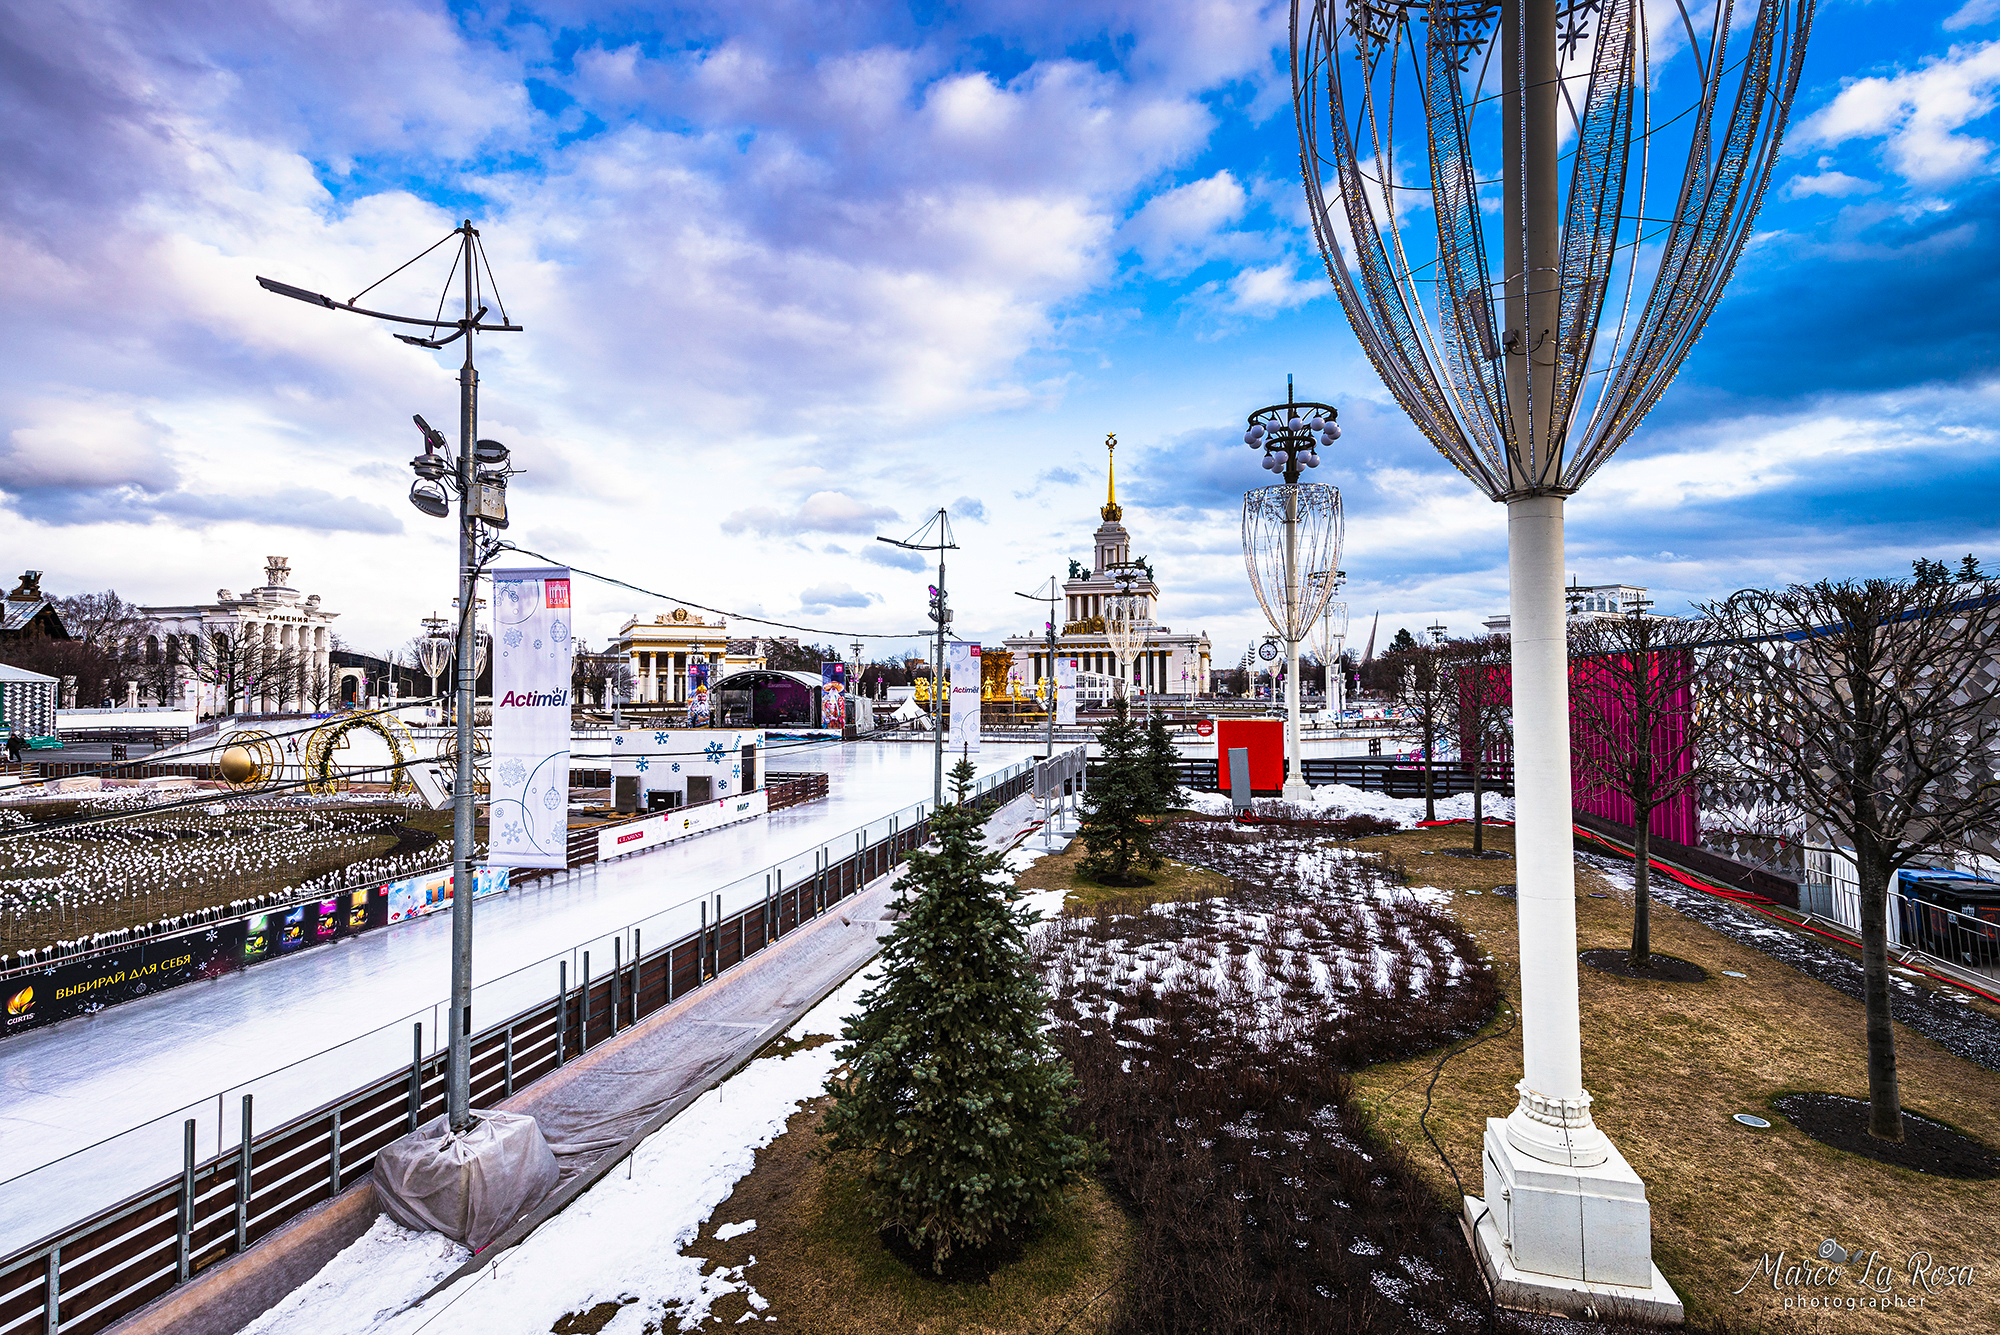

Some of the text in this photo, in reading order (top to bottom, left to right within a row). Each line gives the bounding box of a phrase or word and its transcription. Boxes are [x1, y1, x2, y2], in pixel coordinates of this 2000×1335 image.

[266, 614, 308, 623] АРМЕНИЯ
[952, 685, 979, 694] Actimel
[499, 687, 568, 707] Actimel
[55, 954, 191, 1000] ВЫБИРАЙ ДЛЯ СЕБЯ
[7, 1012, 35, 1025] CURTIS
